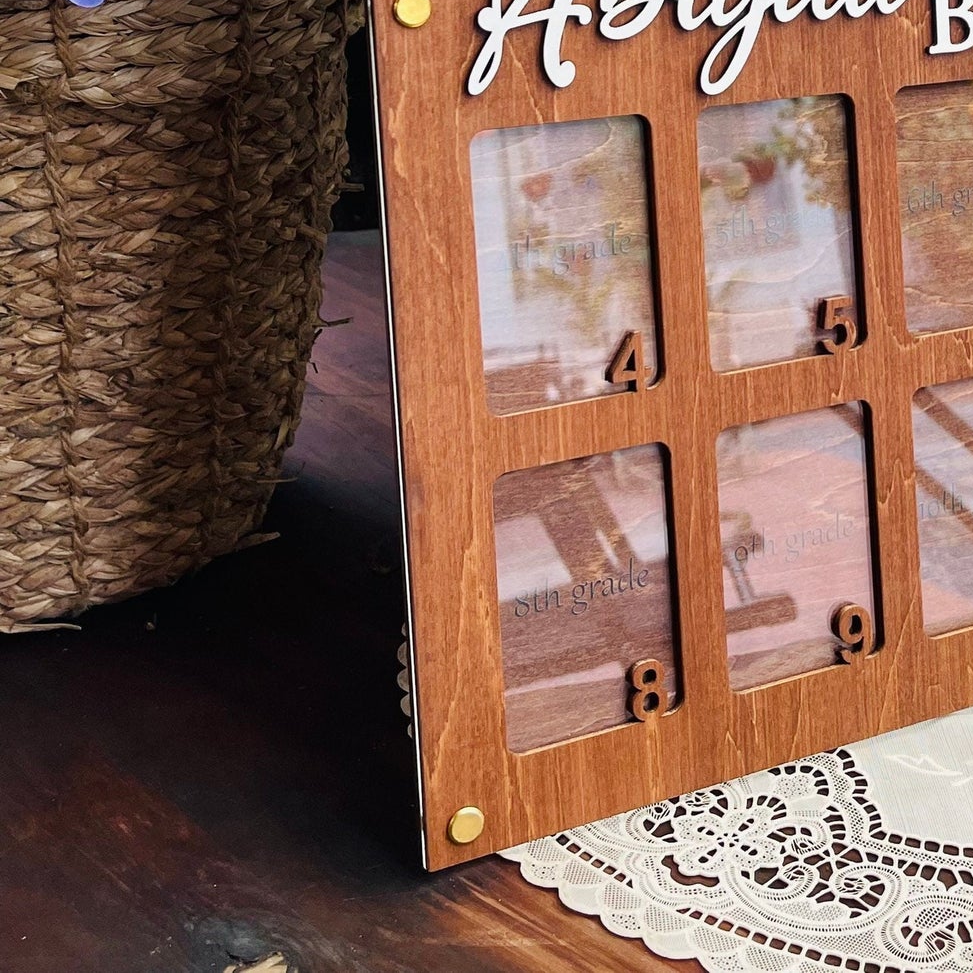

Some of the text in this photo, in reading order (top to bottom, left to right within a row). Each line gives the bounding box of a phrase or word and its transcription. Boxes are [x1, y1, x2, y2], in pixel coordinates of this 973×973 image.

[552, 220, 632, 277] grade
[815, 294, 859, 356] 5
[605, 330, 651, 393] 4
[784, 507, 855, 565] grade
[514, 557, 650, 619] 8th grade
[829, 602, 875, 666] 9
[627, 658, 668, 723] 8
